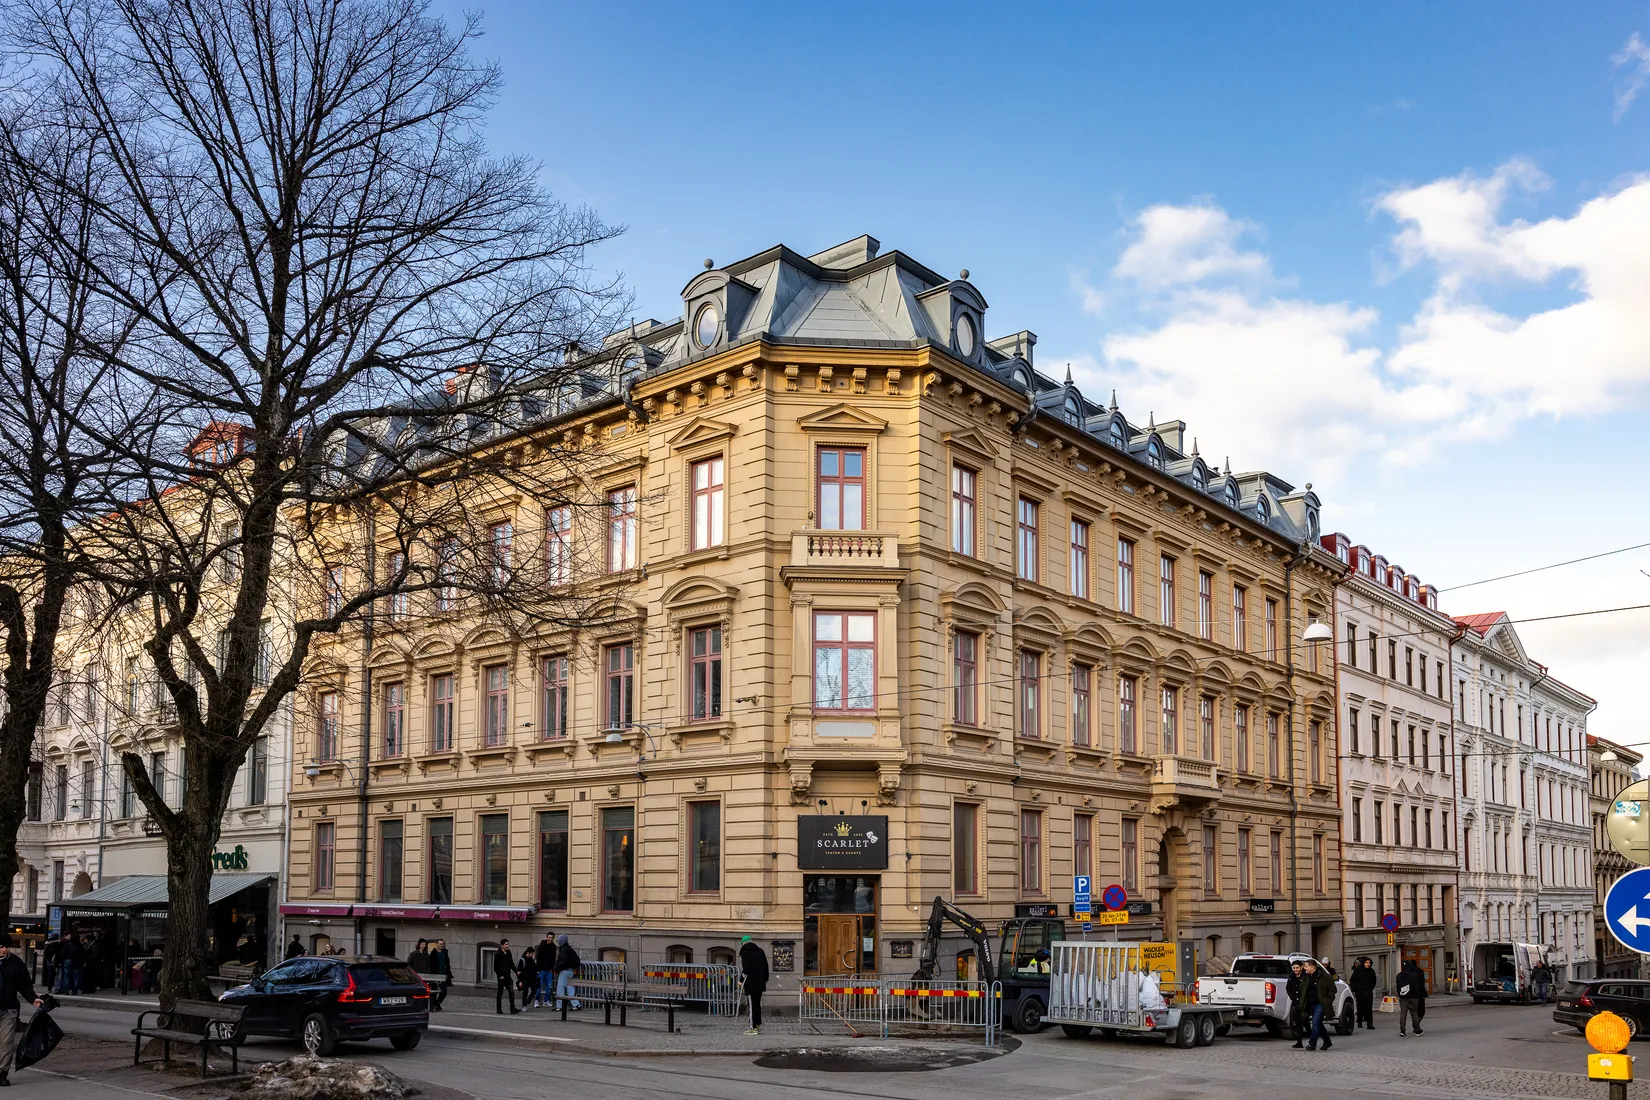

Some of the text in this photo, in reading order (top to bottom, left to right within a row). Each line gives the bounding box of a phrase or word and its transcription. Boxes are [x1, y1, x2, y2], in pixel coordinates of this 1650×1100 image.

[816, 839, 869, 848] SCARLET
[1078, 877, 1087, 893] P
[1029, 905, 1048, 914] galleri
[983, 939, 991, 962] VOLVO
